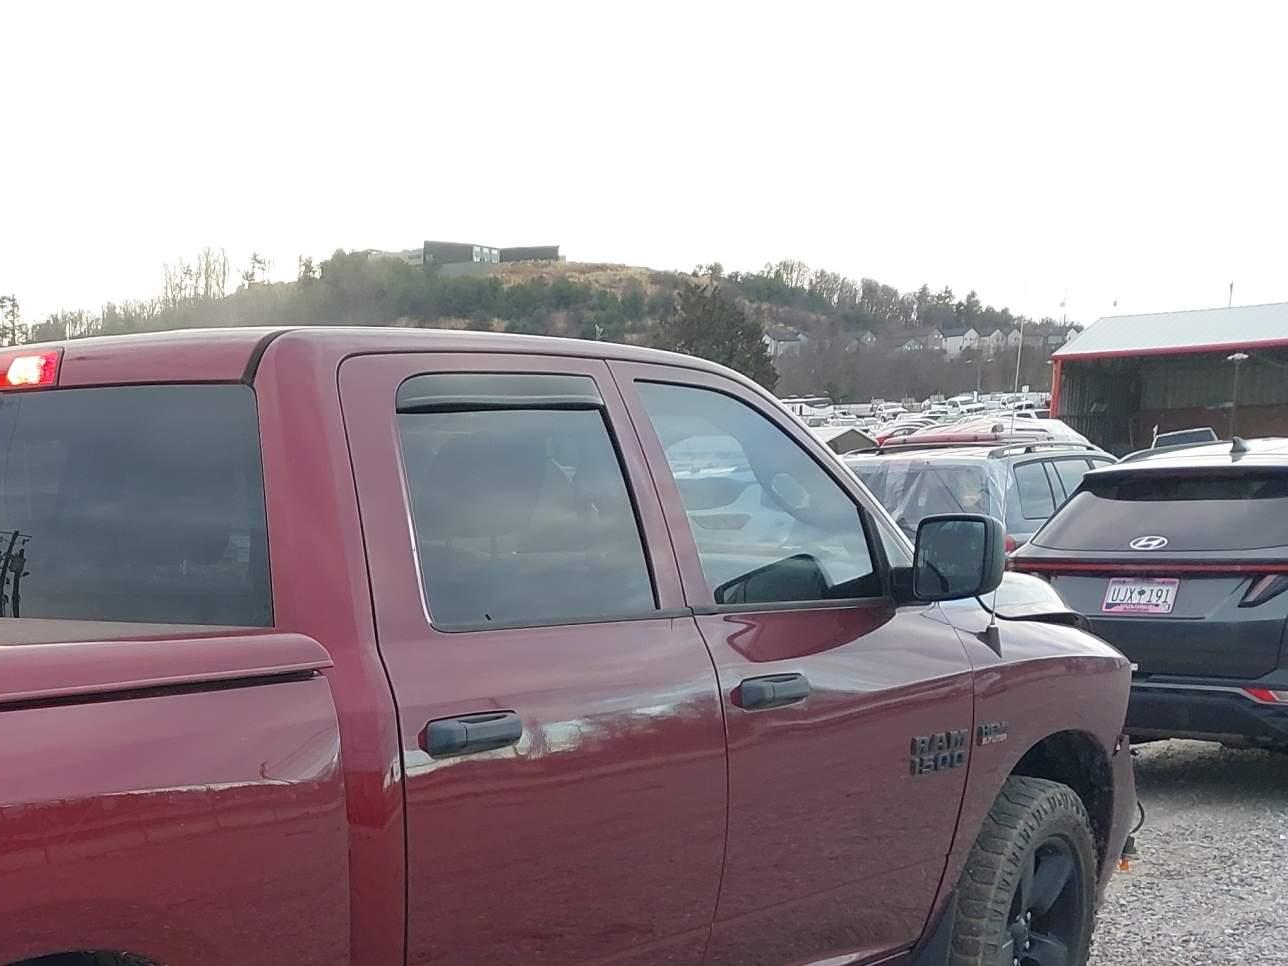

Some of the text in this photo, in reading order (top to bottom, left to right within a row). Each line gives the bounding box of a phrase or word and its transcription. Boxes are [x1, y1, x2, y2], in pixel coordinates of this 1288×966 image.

[1111, 587, 1170, 604] UJX 191
[911, 729, 969, 755] RAM
[910, 750, 967, 776] 1500
